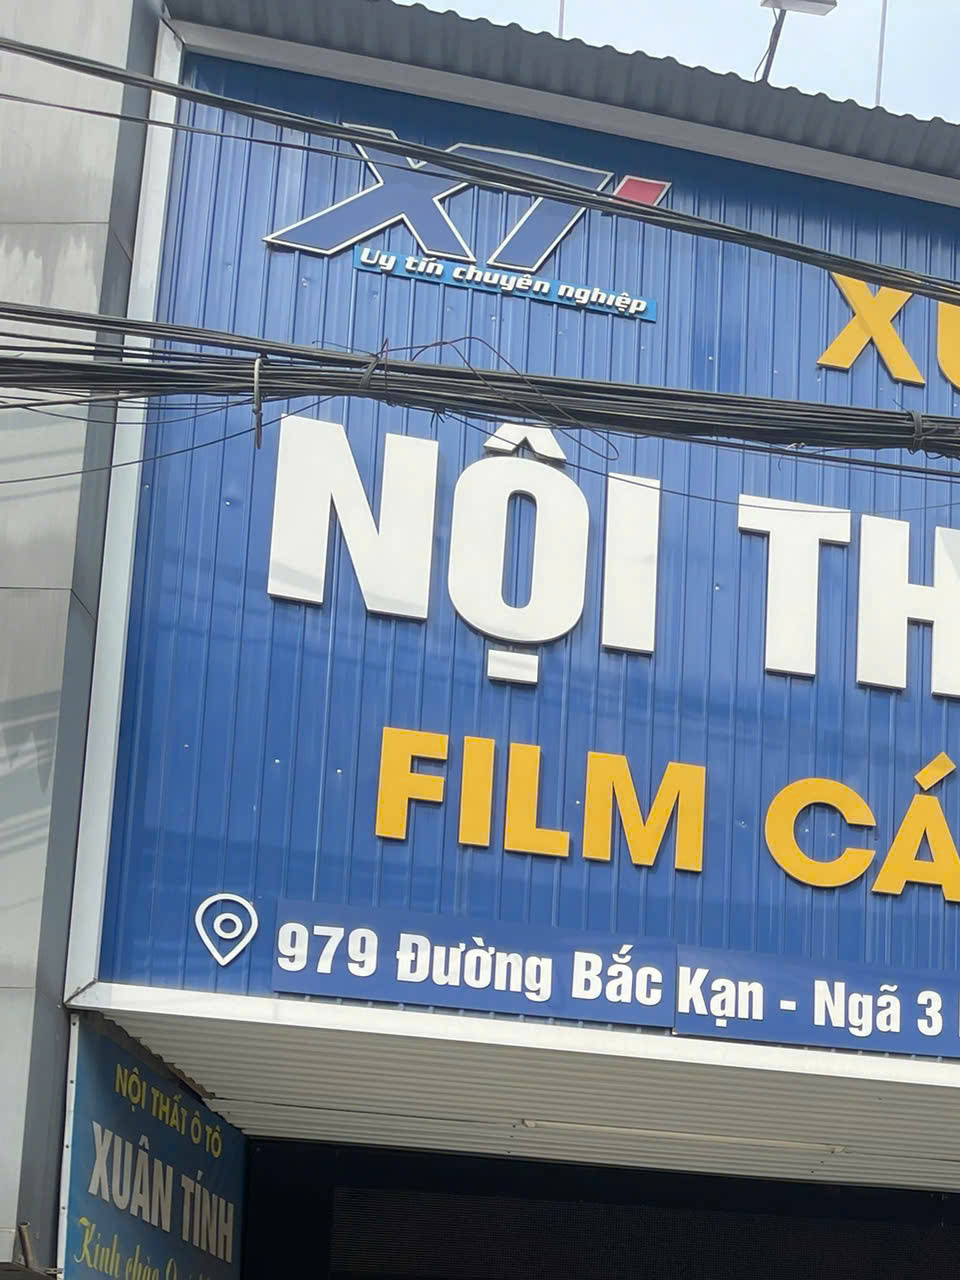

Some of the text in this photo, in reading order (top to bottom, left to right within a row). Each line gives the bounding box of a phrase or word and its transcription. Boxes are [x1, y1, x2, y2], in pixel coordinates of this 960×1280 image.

[360, 246, 648, 316] Uy tín chuyên nghiệp
[267, 413, 662, 686] NỘI
[374, 726, 707, 873] FILM
[277, 921, 379, 978] 979
[396, 932, 553, 1003] Đường
[571, 944, 664, 1007] Bắc
[678, 966, 765, 1029] Kạn
[779, 1000, 797, 1011] -
[813, 980, 902, 1038] Ngã
[916, 991, 944, 1036] 3
[114, 1062, 223, 1158] NỘI THẤT Ô TÔ
[88, 1120, 235, 1264] XUÂN TÍNH
